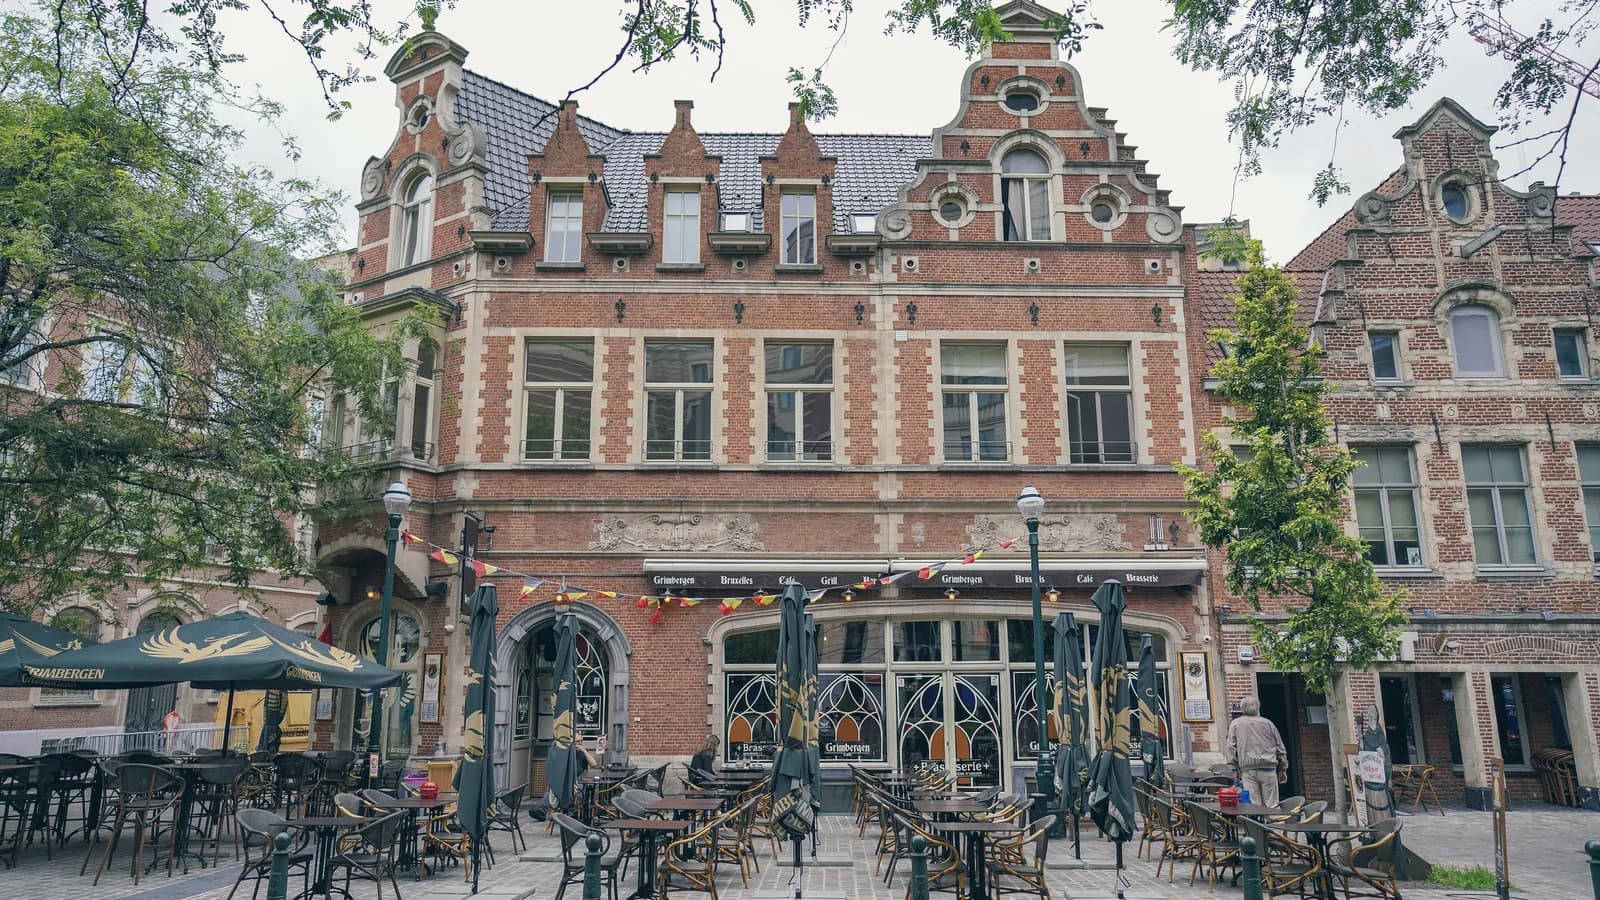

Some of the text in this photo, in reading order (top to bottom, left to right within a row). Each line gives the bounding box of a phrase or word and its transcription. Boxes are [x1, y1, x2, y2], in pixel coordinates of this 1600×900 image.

[1587, 404, 1596, 416] 3
[653, 575, 695, 585] Grimbergen
[720, 575, 753, 585] Bruxelles
[820, 575, 838, 584] Grill
[941, 574, 983, 585] Grimbergen
[1015, 574, 1045, 583] Brusls
[1125, 573, 1159, 583] Brasserie
[825, 742, 870, 753] Grimbergen
